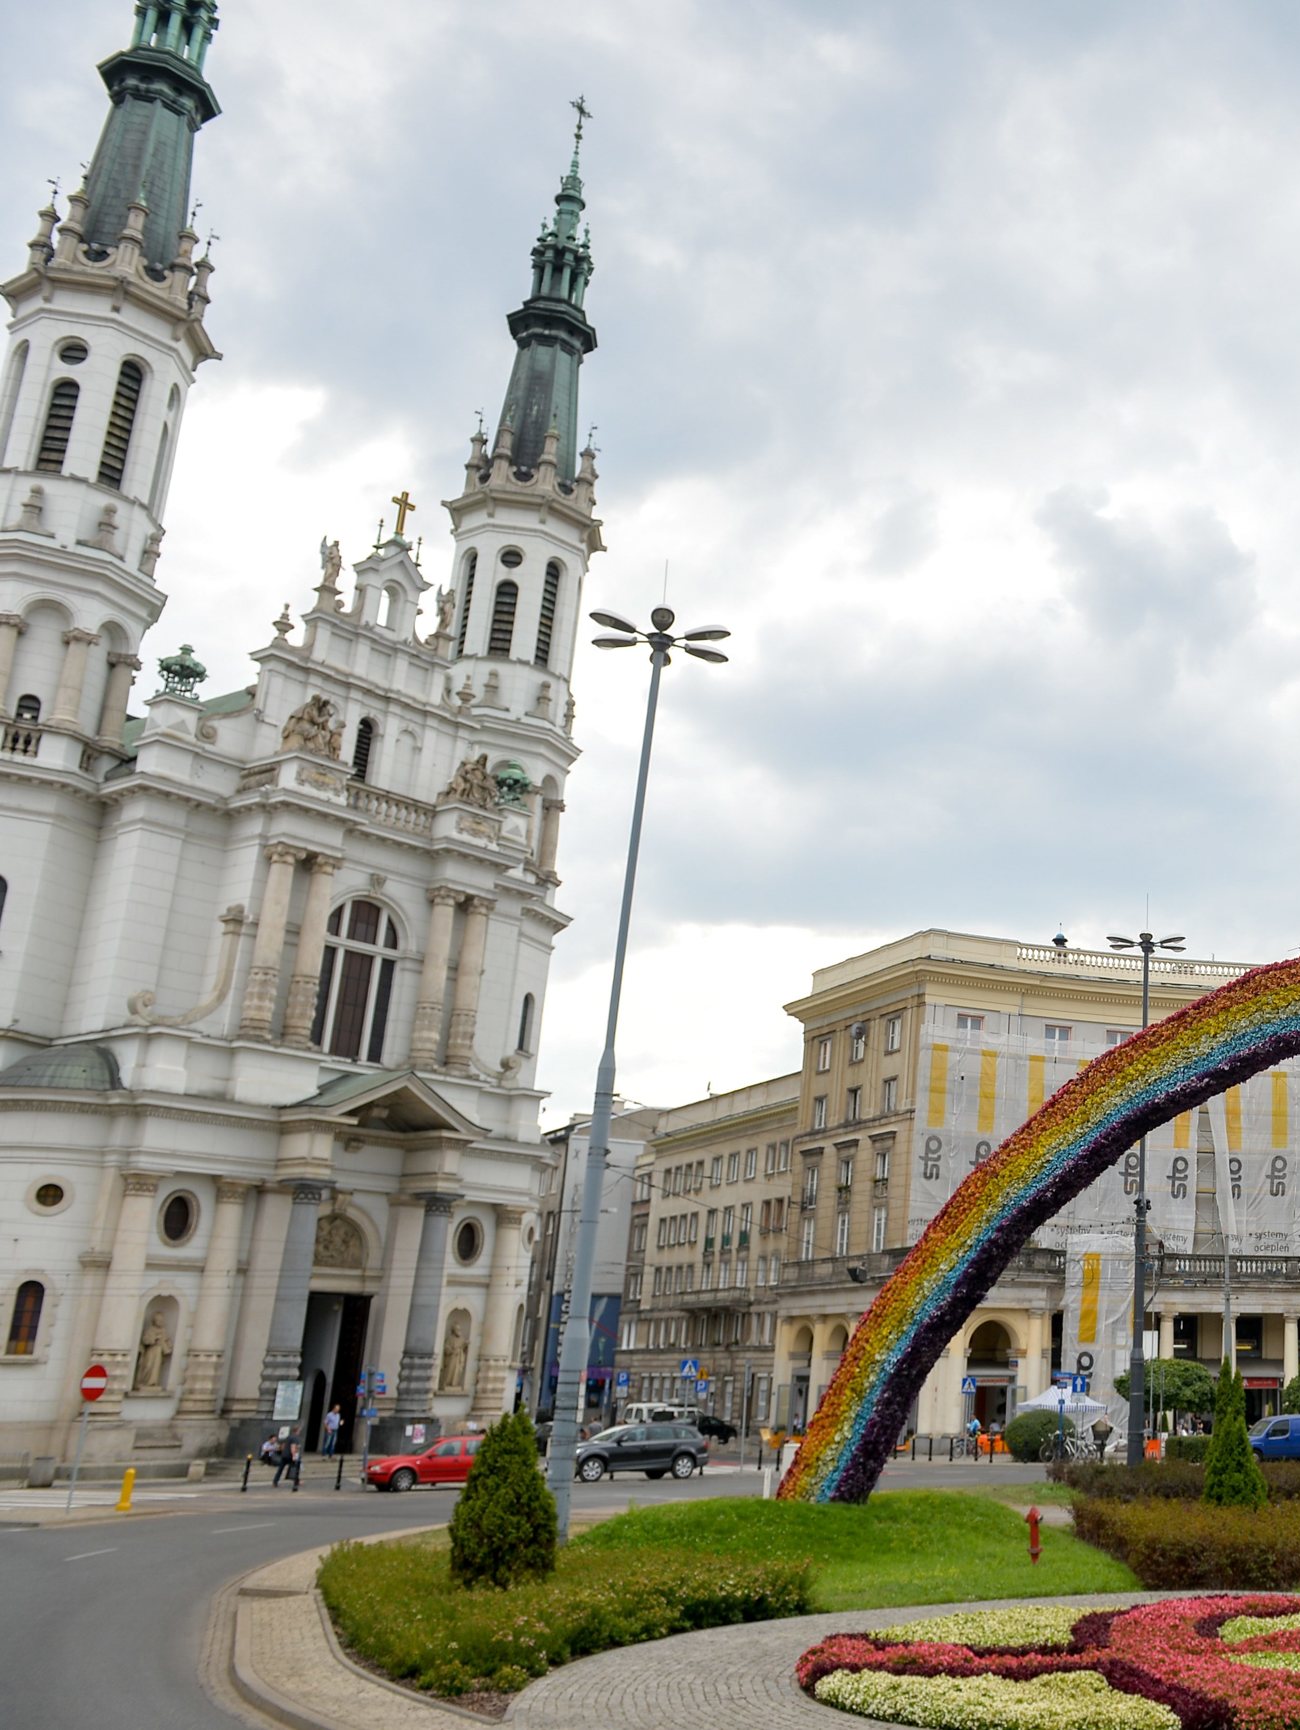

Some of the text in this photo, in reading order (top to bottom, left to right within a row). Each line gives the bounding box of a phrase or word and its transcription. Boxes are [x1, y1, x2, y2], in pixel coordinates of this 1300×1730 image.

[919, 1135, 942, 1180] sto
[1166, 1156, 1188, 1200] sto
[1265, 1155, 1287, 1197] sto
[1254, 1230, 1289, 1241] systemy
